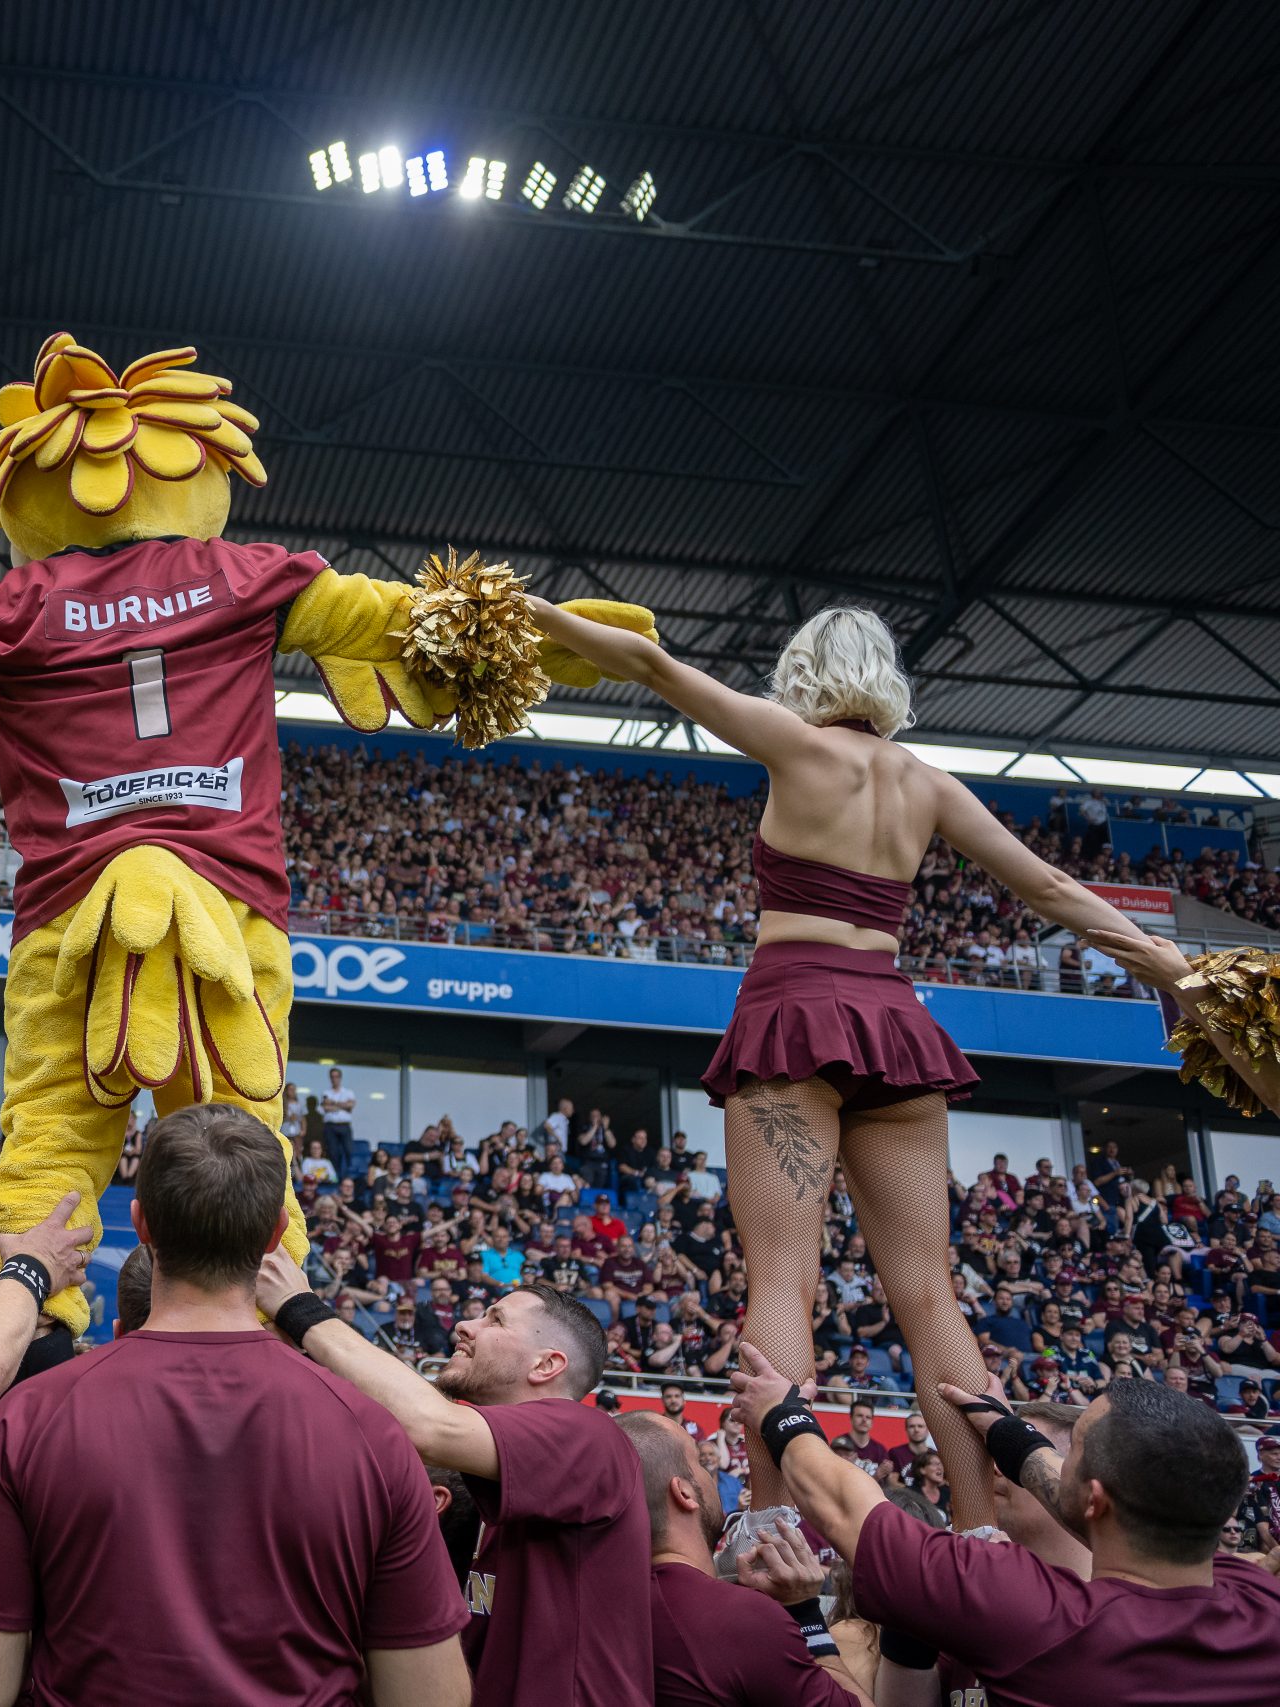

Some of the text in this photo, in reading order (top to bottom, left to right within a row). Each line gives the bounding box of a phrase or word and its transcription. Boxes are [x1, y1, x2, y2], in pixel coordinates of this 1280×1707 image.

[64, 585, 213, 632] BURNIE
[121, 648, 172, 741] 1
[138, 792, 183, 806] SINCE 1933
[1122, 896, 1169, 913] Duisburg
[291, 942, 513, 1003] ape gruppe
